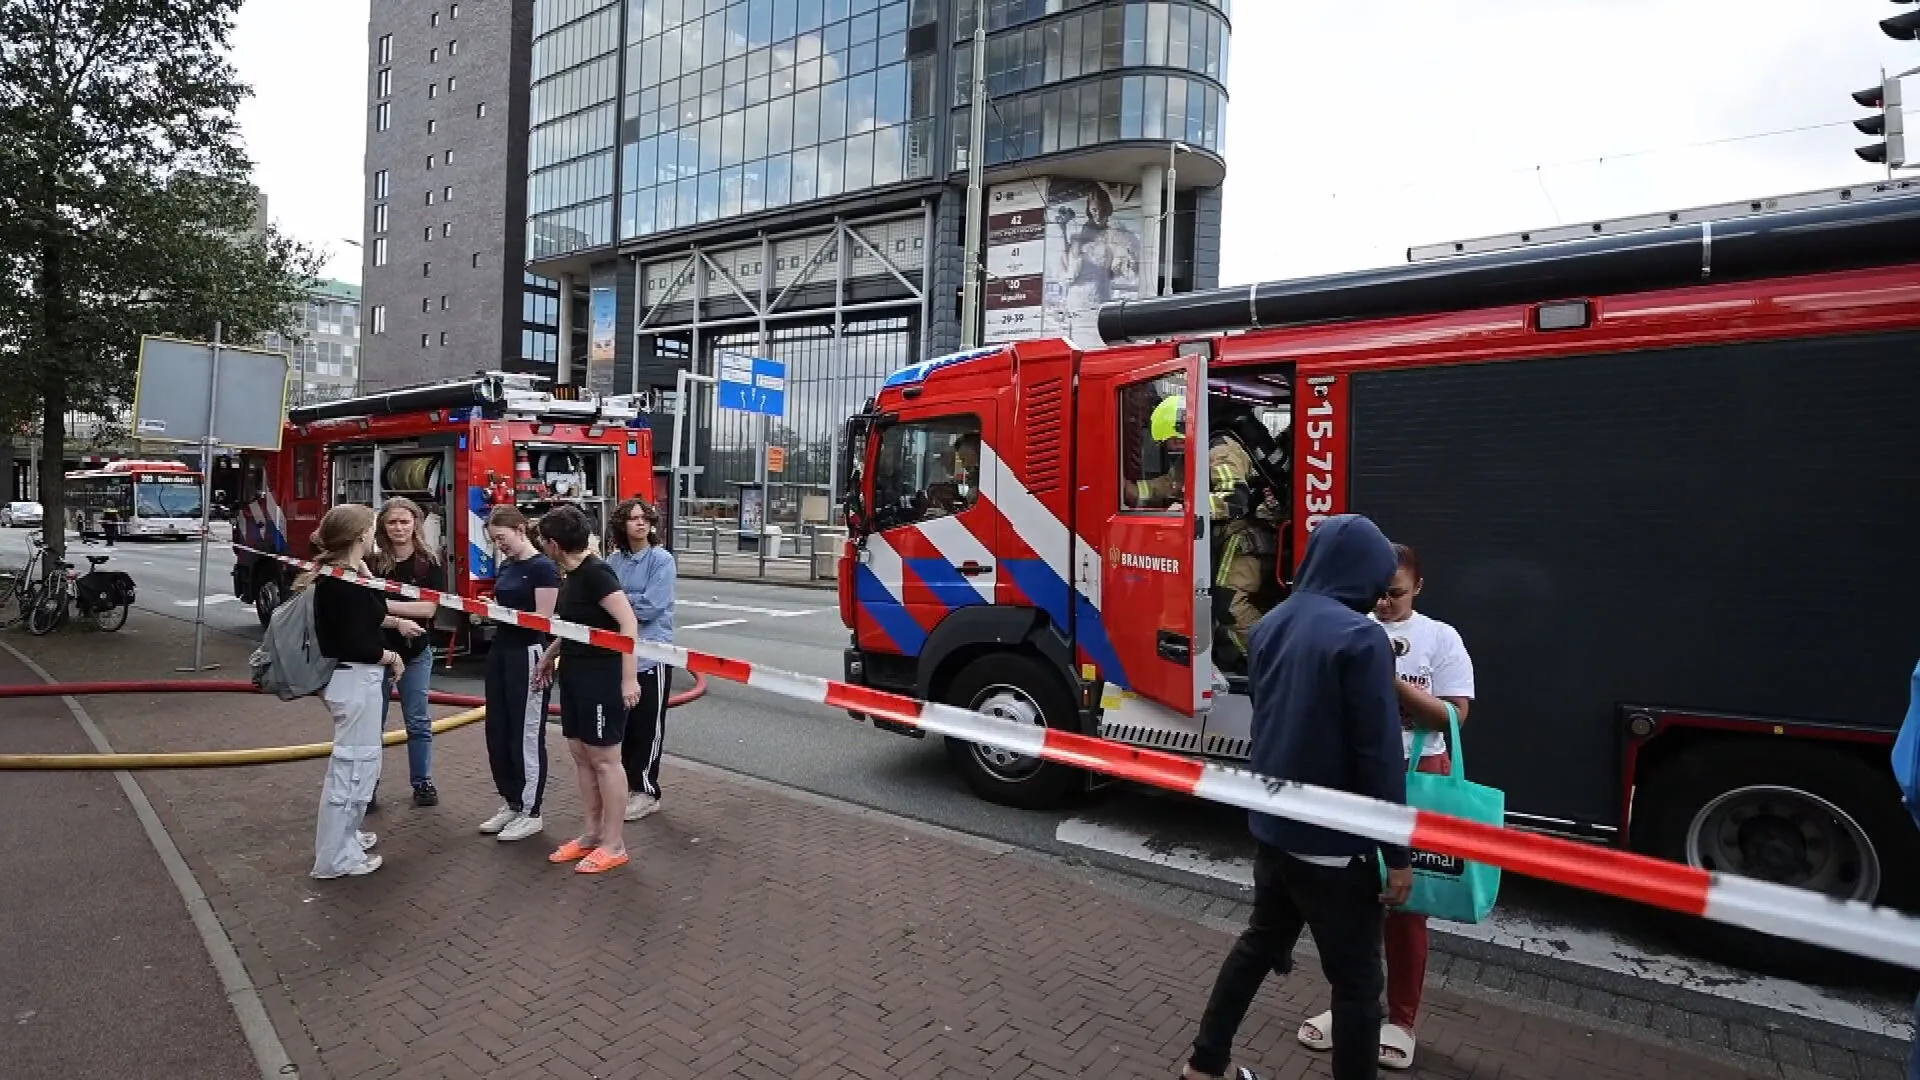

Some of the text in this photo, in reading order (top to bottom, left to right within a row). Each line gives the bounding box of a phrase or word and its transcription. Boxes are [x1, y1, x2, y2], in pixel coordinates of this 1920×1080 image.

[1010, 215, 1022, 225] 42
[1001, 313, 1024, 325] 29-39
[1121, 553, 1179, 575] BRANDWEER
[1411, 851, 1455, 868] ormal
